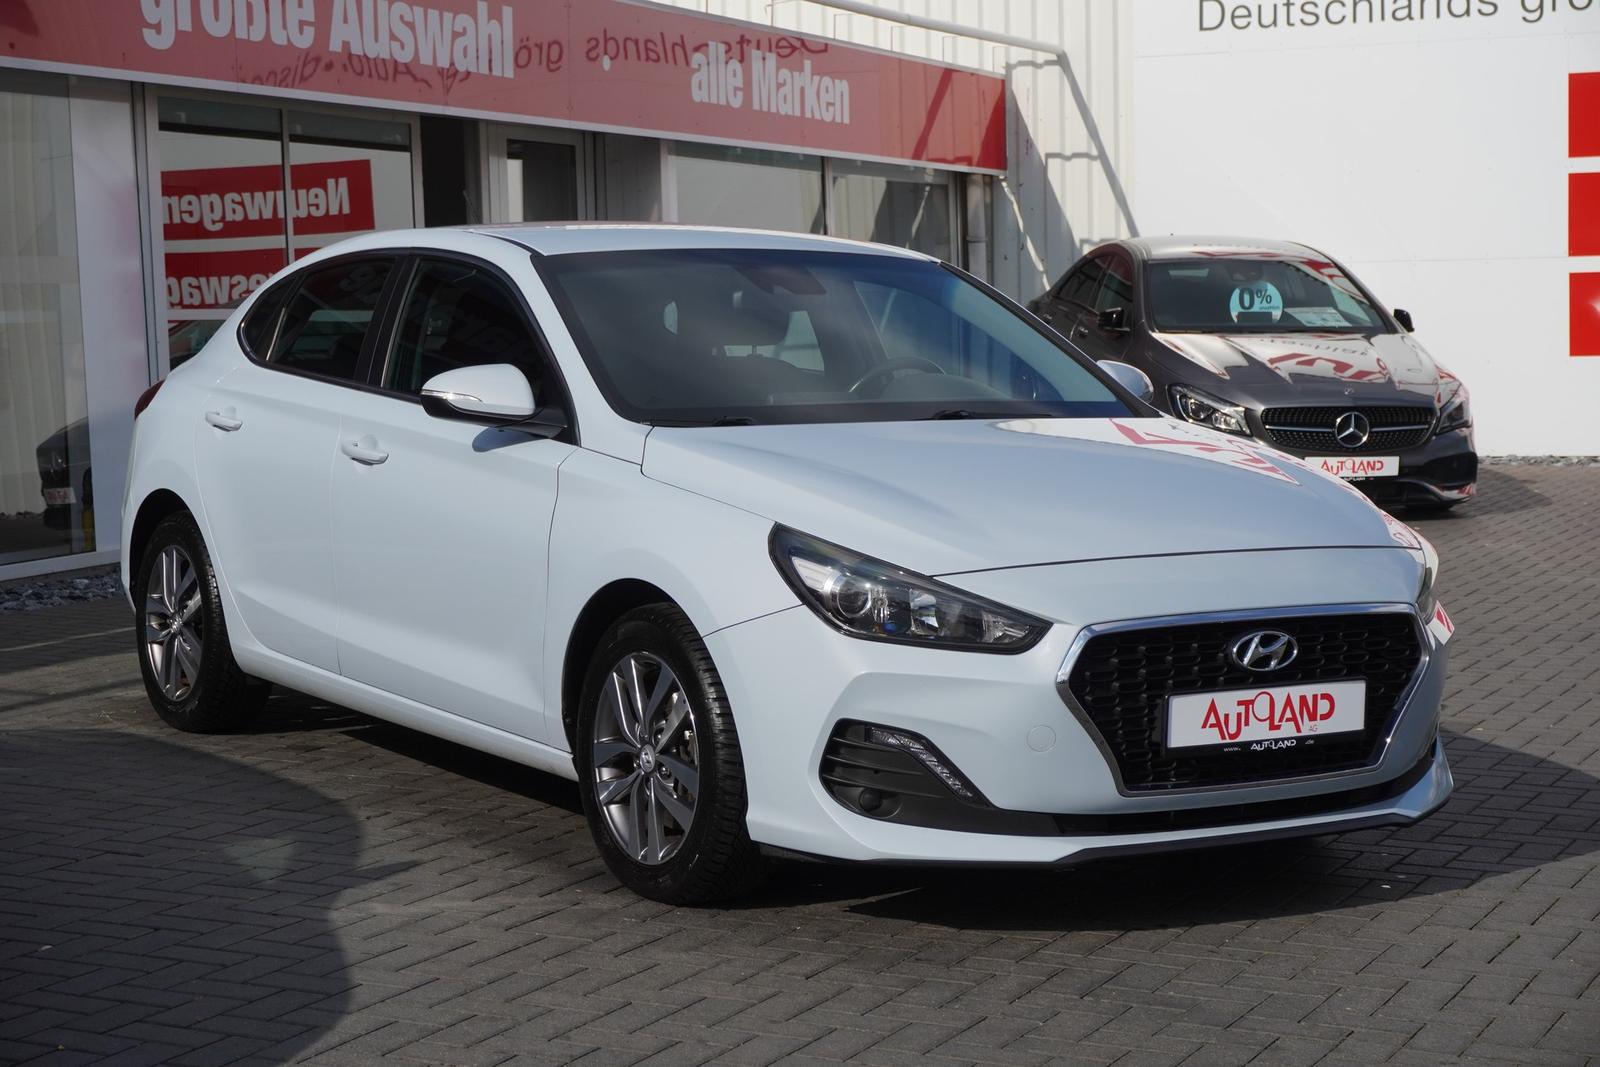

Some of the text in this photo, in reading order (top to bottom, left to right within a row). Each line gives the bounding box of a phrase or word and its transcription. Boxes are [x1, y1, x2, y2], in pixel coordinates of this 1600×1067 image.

[1198, 0, 1499, 32] Deutschlands
[329, 0, 514, 79] Auswahl
[690, 40, 743, 108] alle
[752, 49, 850, 124] Marken
[1238, 287, 1272, 310] 0%
[1201, 691, 1336, 740] AUTOLAND
[1250, 739, 1297, 751] AUTOLAND
